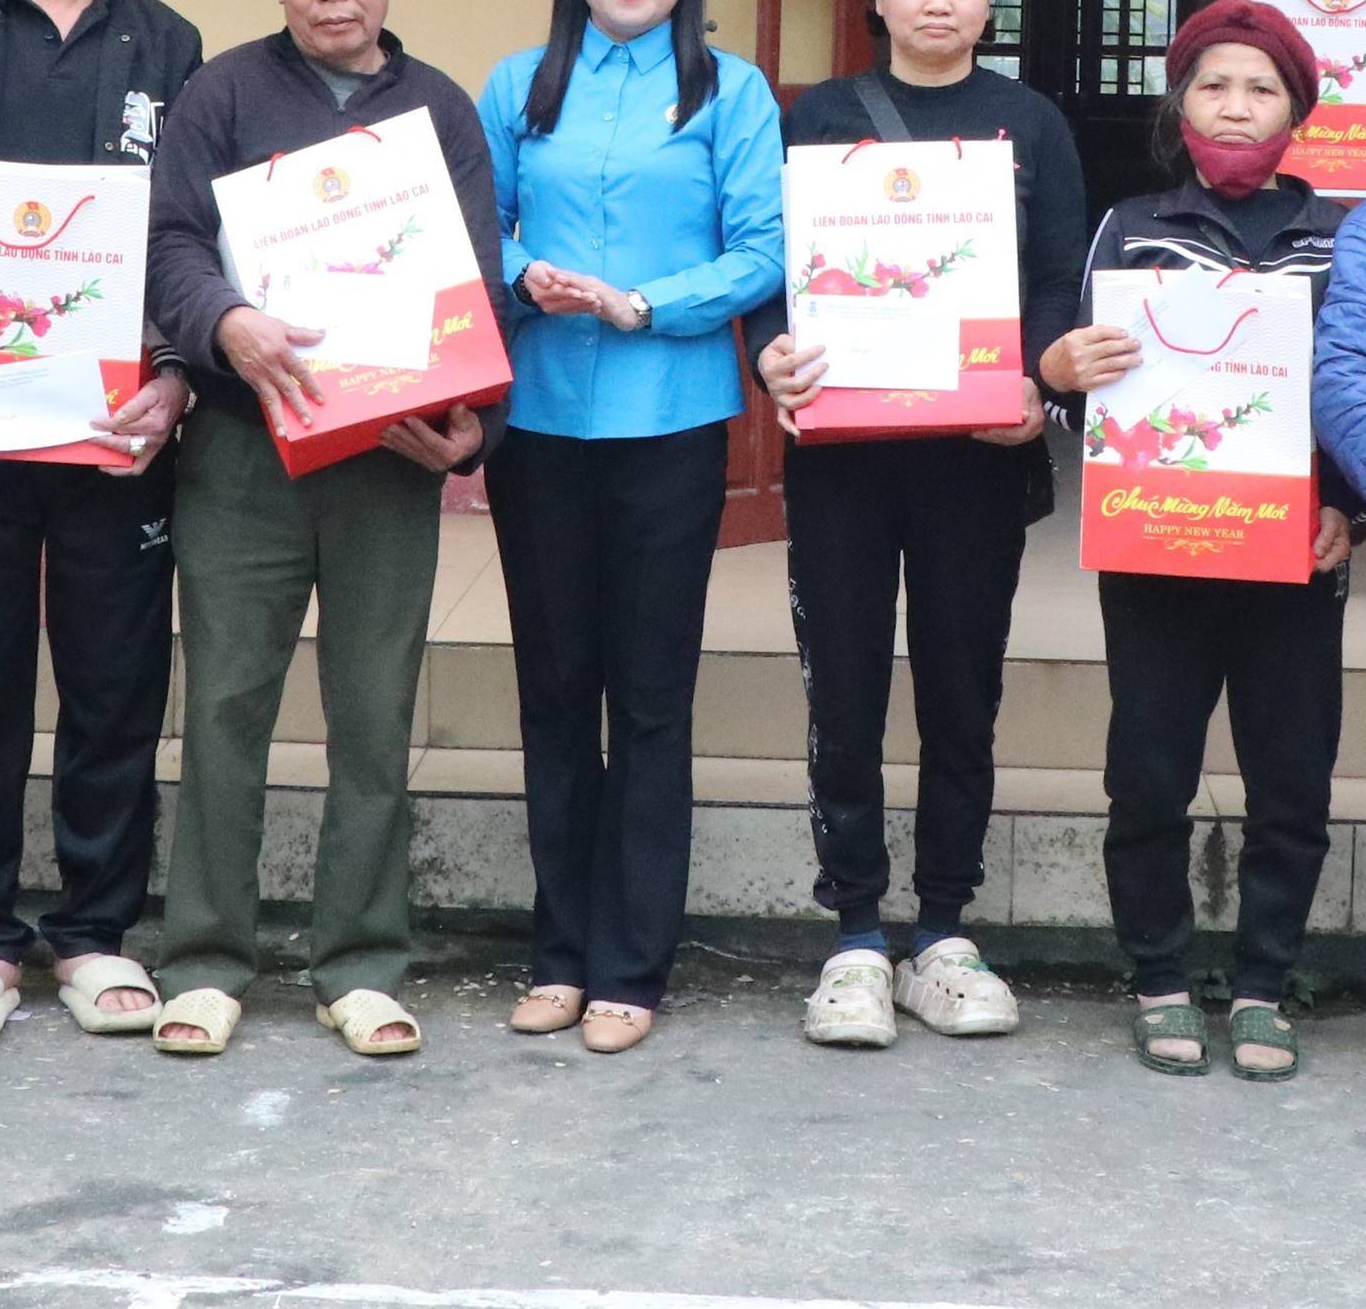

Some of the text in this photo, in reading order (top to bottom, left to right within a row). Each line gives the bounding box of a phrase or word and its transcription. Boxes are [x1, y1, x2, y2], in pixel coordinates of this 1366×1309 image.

[1225, 361, 1288, 377] TỈNH LÀO CAI
[1101, 486, 1289, 524] Chúc Mừng Năm Mới
[1144, 523, 1244, 539] HAPPY NEW YEAR
